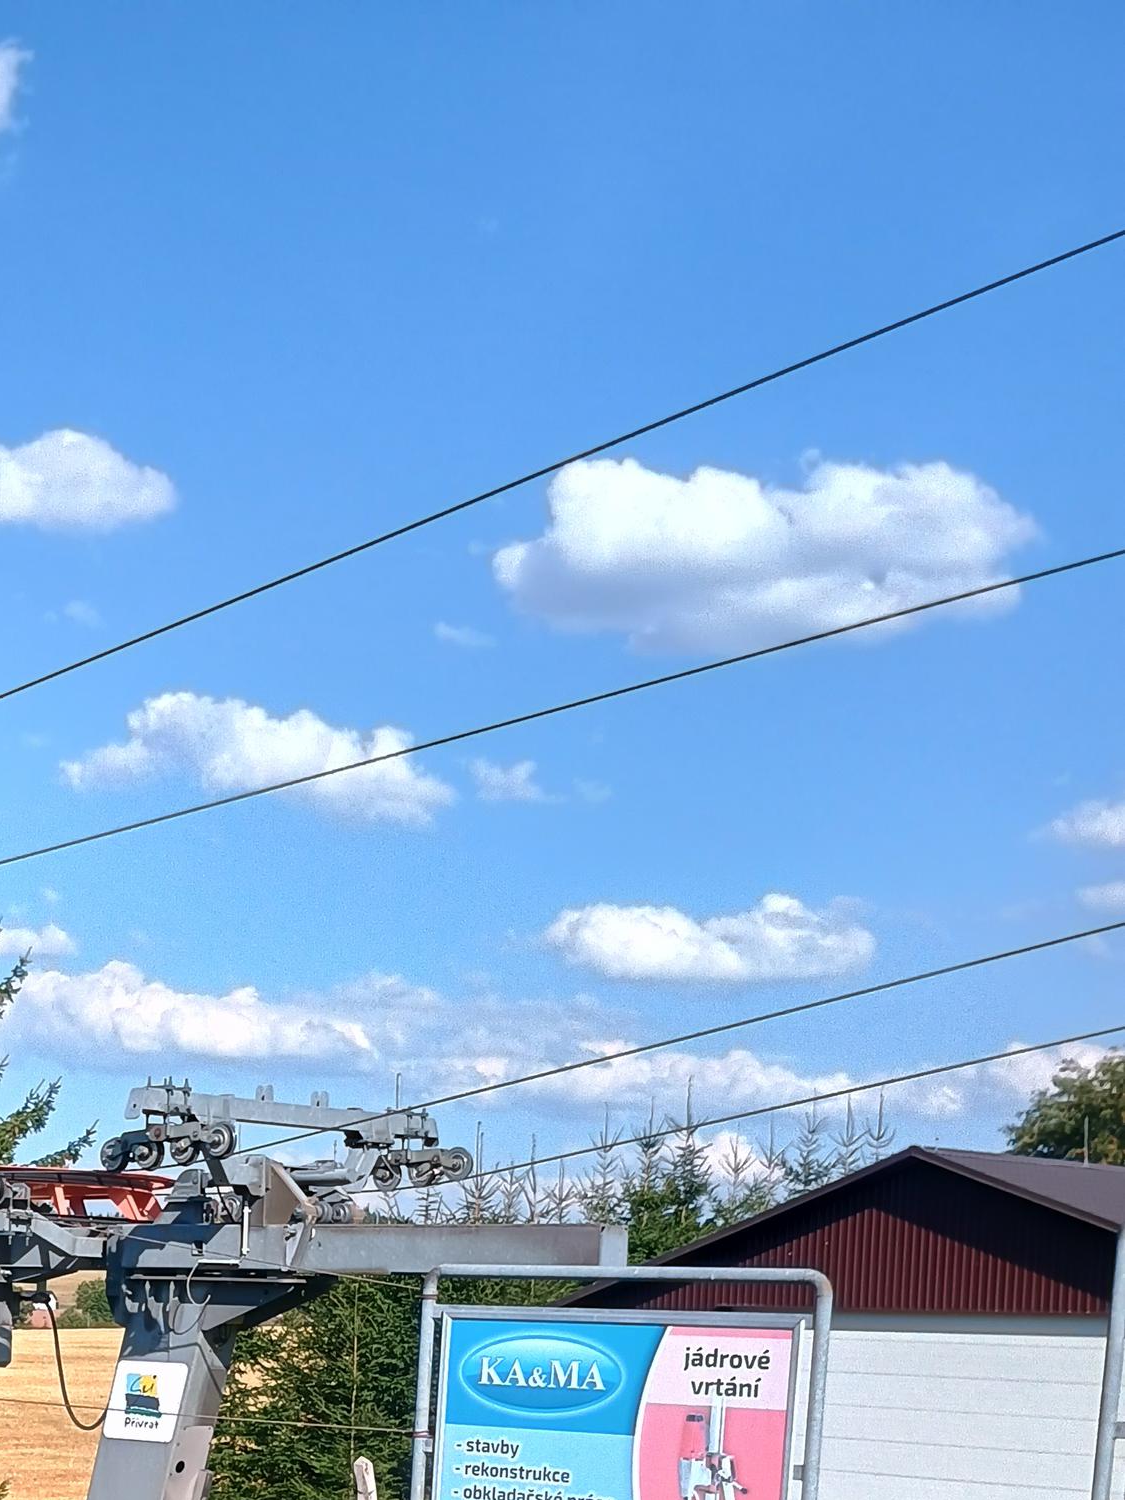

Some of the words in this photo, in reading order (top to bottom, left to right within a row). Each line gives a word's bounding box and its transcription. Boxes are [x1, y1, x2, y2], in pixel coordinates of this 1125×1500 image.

[683, 1346, 771, 1371] jádrové
[478, 1356, 606, 1391] KA&MA
[691, 1376, 762, 1398] vrtání
[466, 1439, 519, 1458] stavby
[464, 1462, 570, 1483] rekonstrukce
